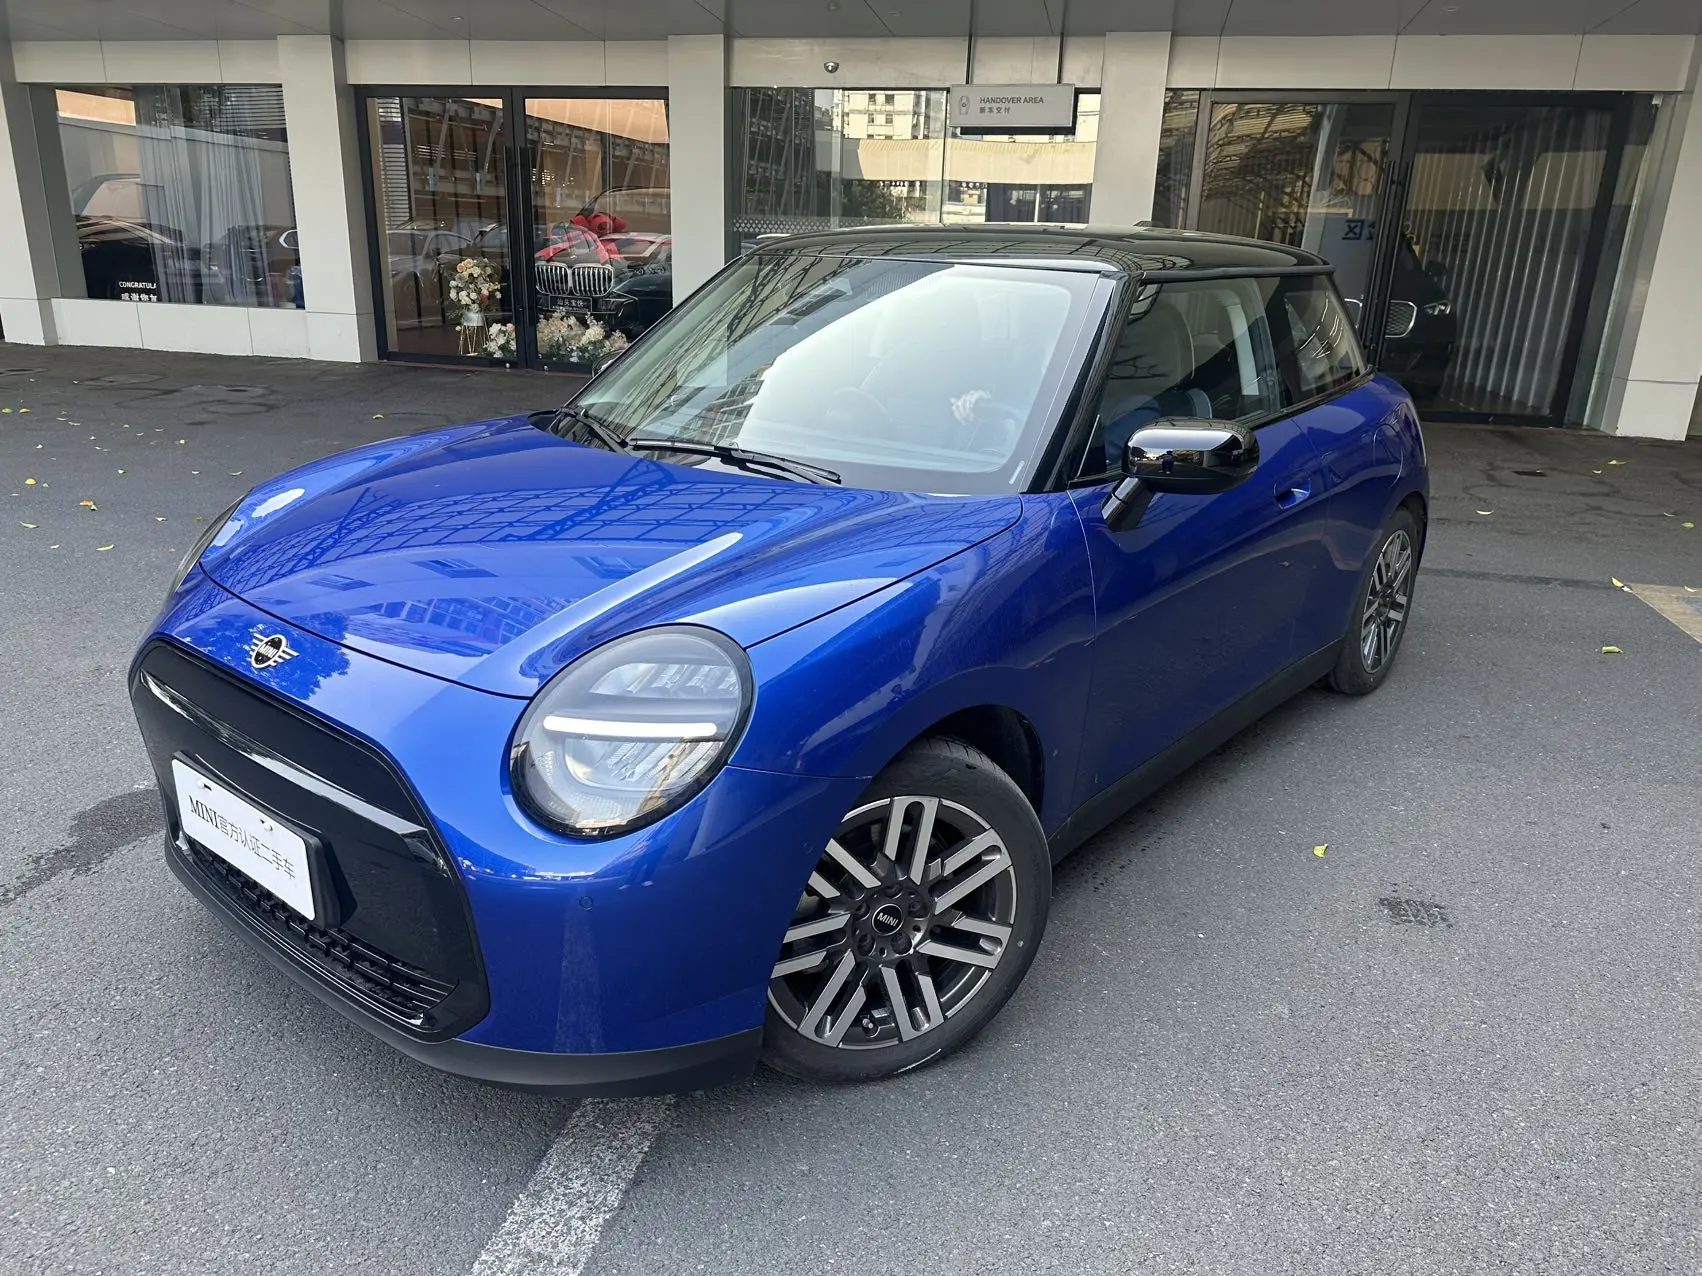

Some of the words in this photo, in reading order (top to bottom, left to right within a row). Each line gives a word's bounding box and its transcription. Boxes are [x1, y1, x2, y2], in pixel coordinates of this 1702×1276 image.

[979, 96, 1022, 104] HANDOVER
[1023, 96, 1044, 104] AREA
[979, 106, 1011, 114] 新车交付
[877, 912, 899, 927] MINI
